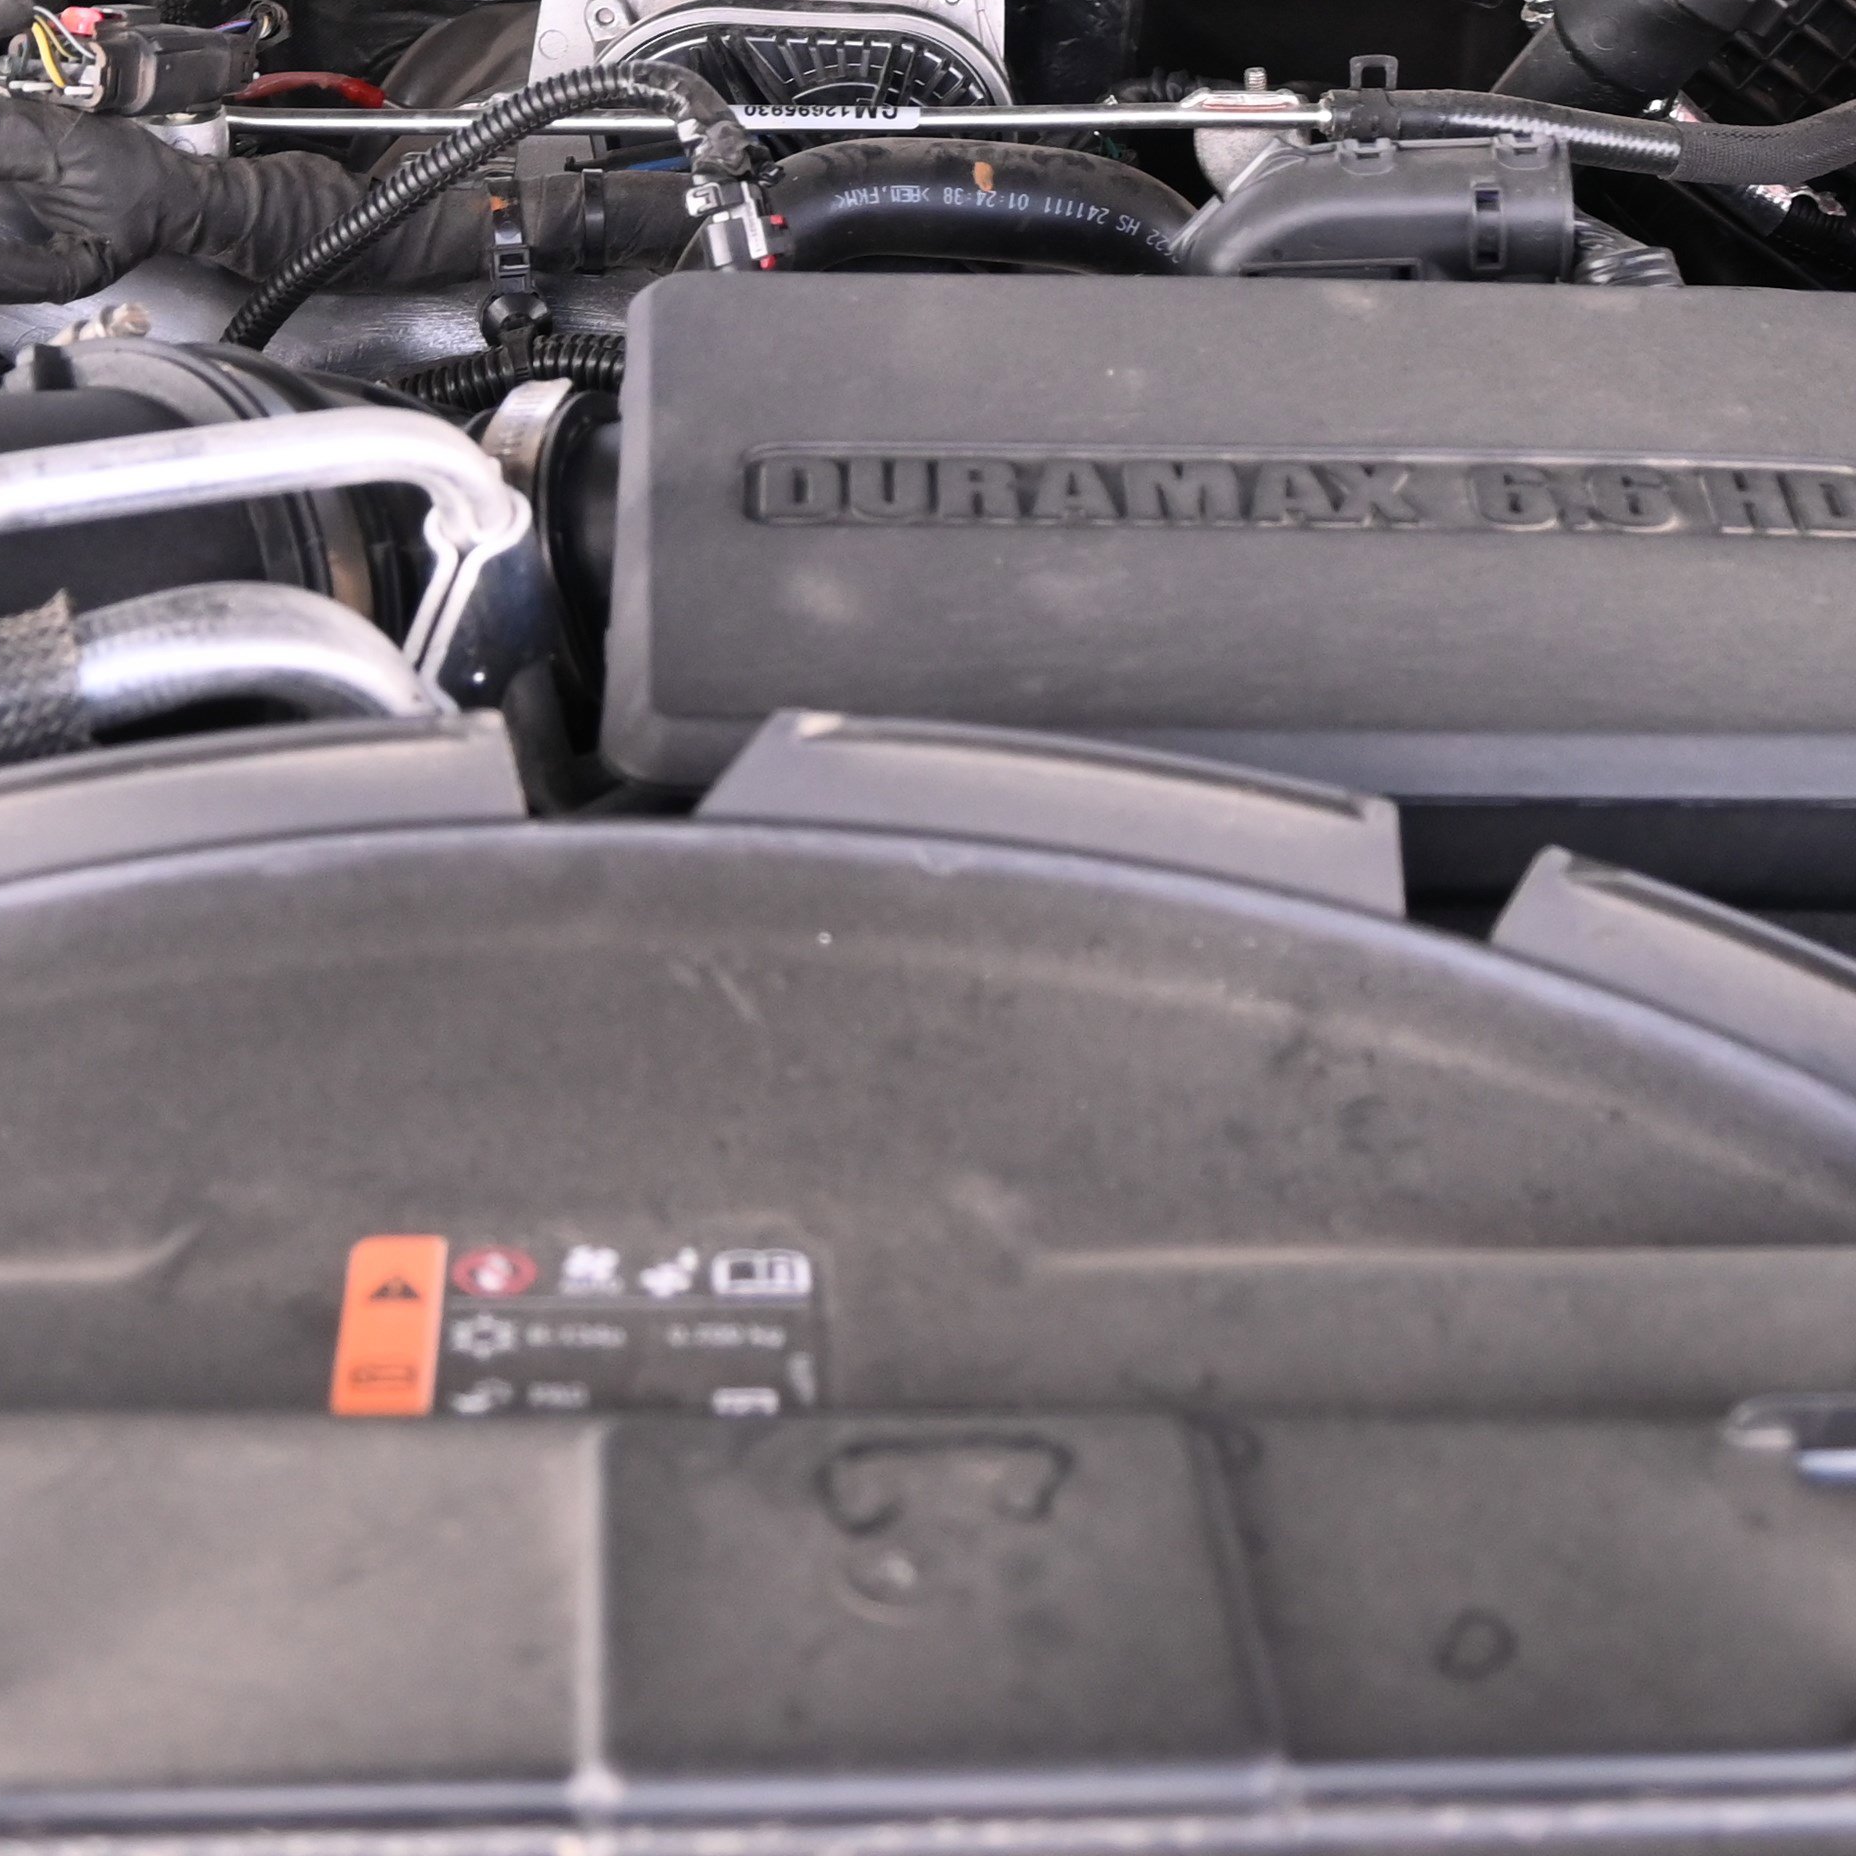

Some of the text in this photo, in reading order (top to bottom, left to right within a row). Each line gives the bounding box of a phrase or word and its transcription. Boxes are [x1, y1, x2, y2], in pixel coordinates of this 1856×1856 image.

[943, 187, 1030, 211] 01:24:38
[1044, 196, 1111, 225] 241111
[1115, 214, 1141, 236] HS
[748, 456, 1419, 530] DURAMAX
[1464, 460, 1684, 534] 6.6
